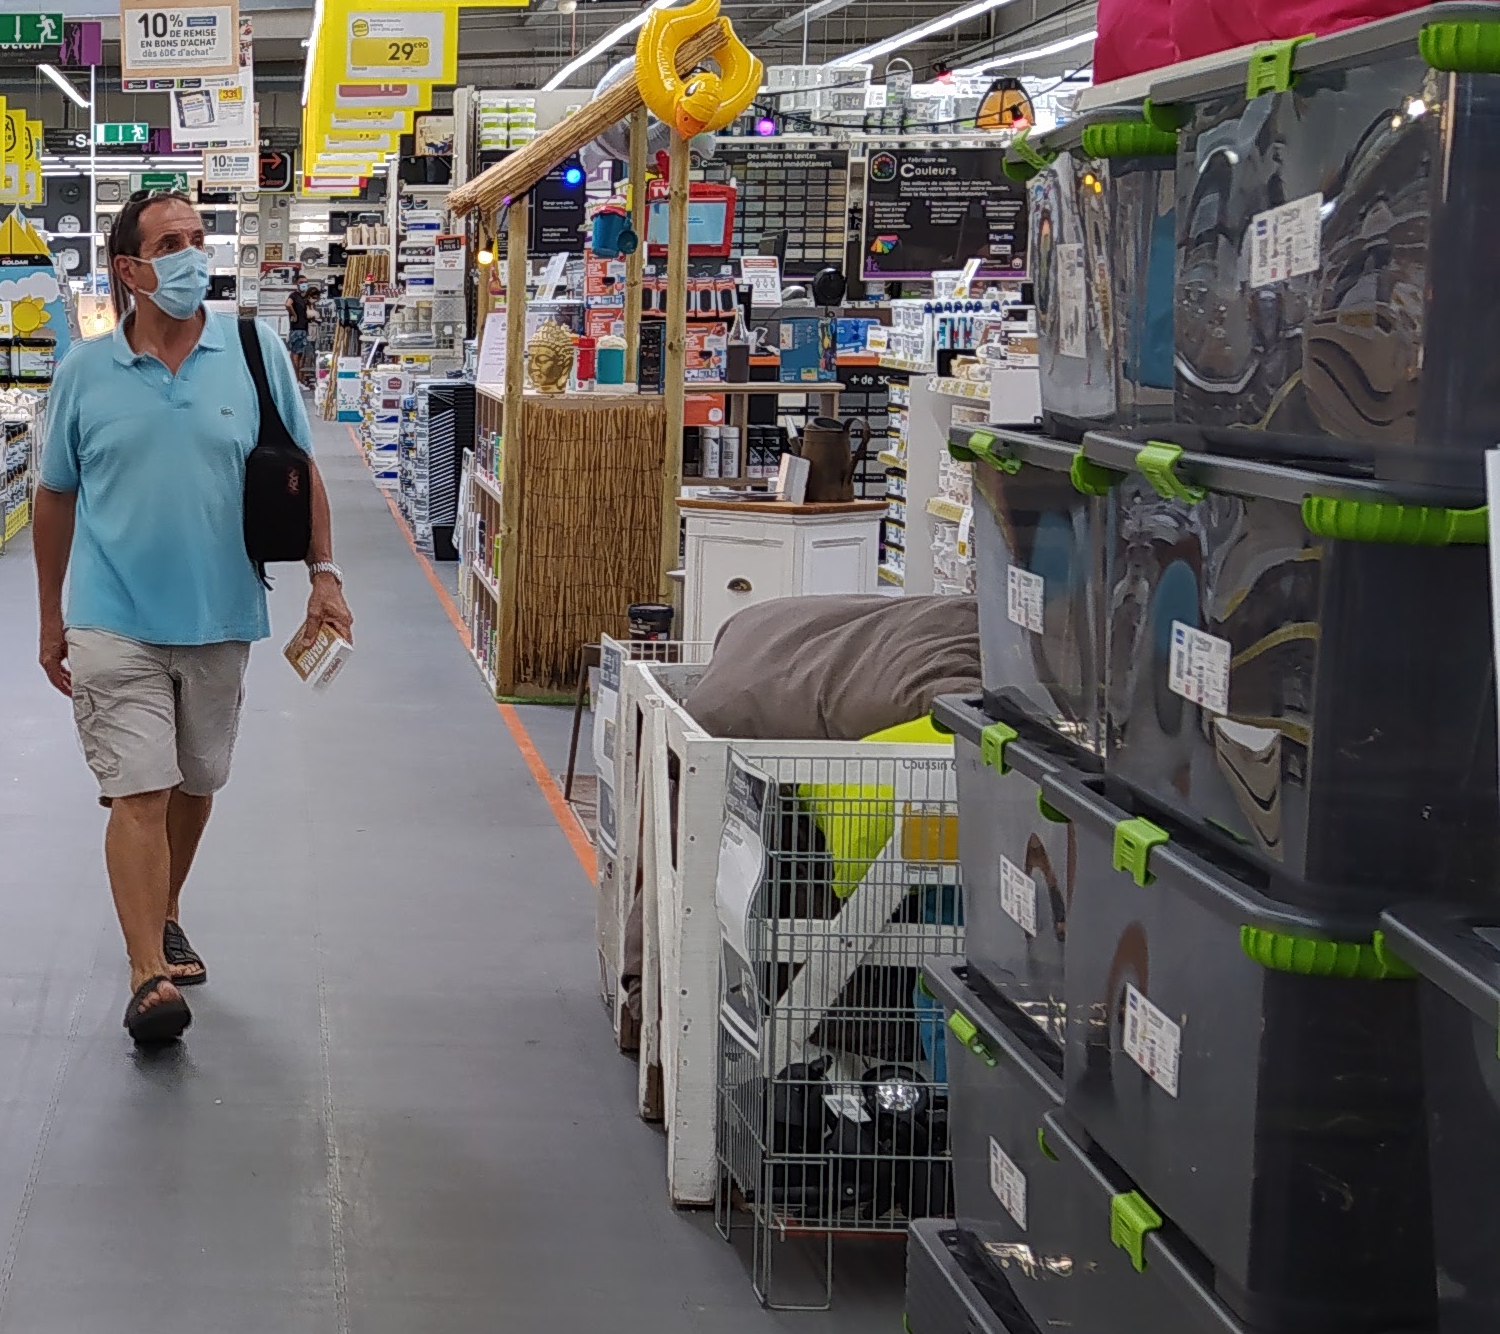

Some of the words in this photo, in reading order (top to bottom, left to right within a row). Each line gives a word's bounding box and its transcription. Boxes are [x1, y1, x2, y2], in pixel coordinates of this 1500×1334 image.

[184, 29, 216, 37] REMISE
[141, 40, 152, 48] EN
[154, 39, 178, 47] BONS
[181, 38, 216, 47] D'ACHAT
[901, 164, 957, 177] Couleurs
